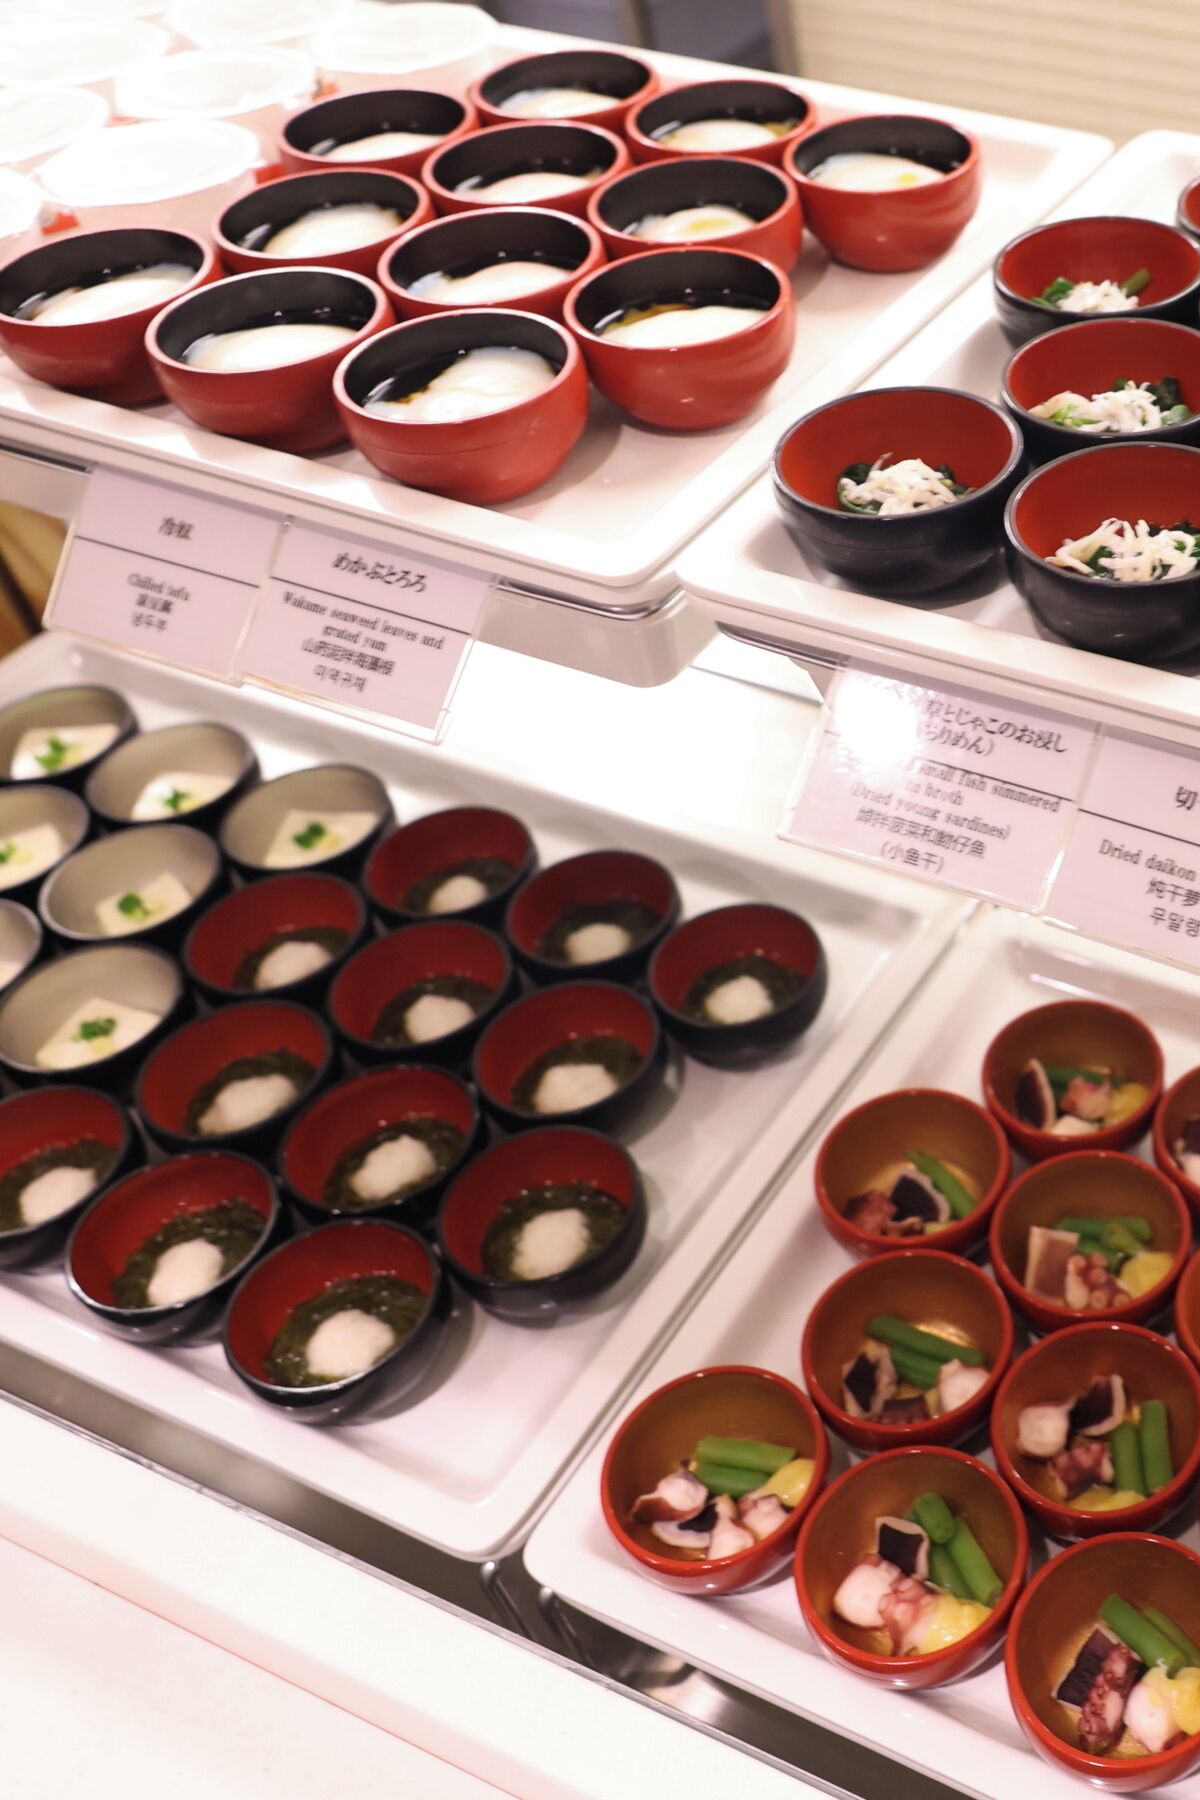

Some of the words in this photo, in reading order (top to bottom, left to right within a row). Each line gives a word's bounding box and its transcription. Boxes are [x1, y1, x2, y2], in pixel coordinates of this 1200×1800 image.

[331, 552, 428, 593] めかぶとろろ
[322, 625, 362, 645] grated
[362, 636, 389, 652] yam
[329, 609, 381, 631] seaweed
[381, 619, 419, 643] leaves
[420, 635, 447, 651] and
[919, 764, 955, 783] small
[957, 771, 987, 792] fish
[991, 783, 1062, 813] simmered
[924, 782, 964, 806] broth
[894, 798, 942, 821] young
[945, 812, 1012, 841] sardines)
[1098, 838, 1142, 865] Dried
[1144, 854, 1197, 883] daikon
